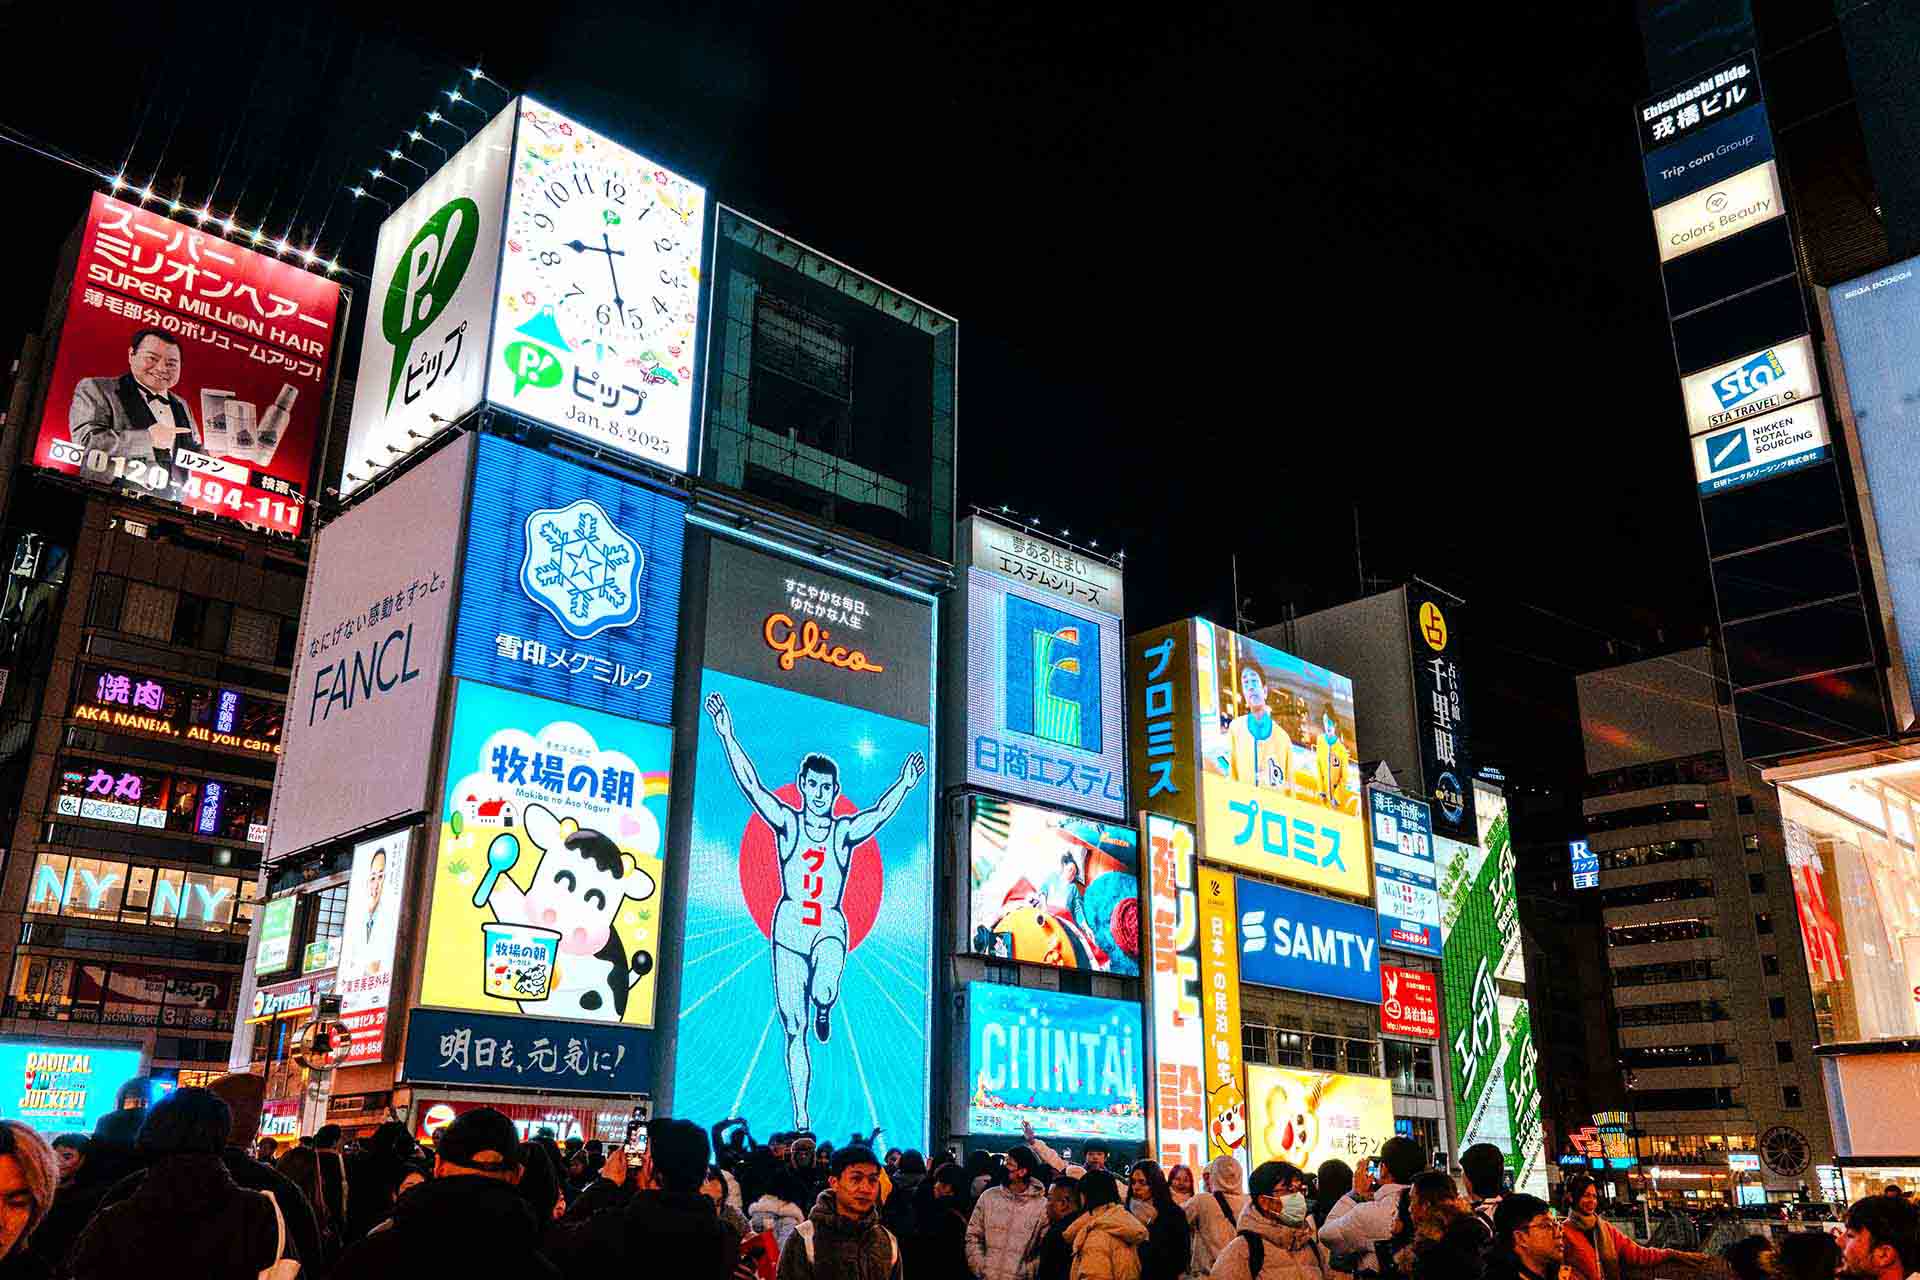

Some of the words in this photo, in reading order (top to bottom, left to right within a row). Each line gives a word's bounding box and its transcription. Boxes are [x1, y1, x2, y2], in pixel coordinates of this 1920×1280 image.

[1643, 78, 1714, 121] Ebisubashi
[1652, 85, 1748, 140] 戎橋ビル
[1661, 152, 1715, 180] Trip.com
[1716, 134, 1754, 156] Group
[544, 181, 571, 209] 10
[571, 173, 596, 197] 11
[604, 178, 626, 205] 12
[98, 203, 235, 264] スーパー
[534, 213, 555, 233] 9
[1670, 220, 1715, 246] Colors
[1719, 198, 1770, 228] Beauty
[94, 233, 329, 329] ミリオンヘアー
[540, 250, 561, 267] 8
[87, 264, 173, 301] SUPER
[179, 296, 263, 335] MILLION
[270, 328, 324, 357] HAIR
[596, 303, 611, 326] 6
[627, 307, 643, 330] 5
[404, 320, 468, 404] ピップ
[572, 364, 648, 416] ピップ
[1711, 411, 1733, 425] STA
[1735, 398, 1777, 418] TRAVEL
[1752, 418, 1794, 436] NIKKEN
[1753, 429, 1789, 444] TOTAL
[1756, 430, 1813, 454] SOURCING
[180, 453, 225, 474] ルアン
[262, 475, 289, 495] 検索
[87, 450, 299, 528] 0120-494-111
[1012, 536, 1088, 575] 夢ある住まい
[309, 572, 446, 658] なにげない感動をずっと。
[791, 597, 864, 630] ゆたかな人生
[1426, 606, 1442, 644] 占
[496, 633, 652, 691] 雪印メグミルク
[764, 612, 884, 672] Glico
[96, 672, 165, 711] 焼肉
[308, 623, 420, 727] FANCL
[75, 704, 110, 723] AKA
[187, 727, 209, 742] All
[212, 730, 240, 748] you
[243, 737, 270, 752] can
[1145, 638, 1180, 797] プロミス
[86, 769, 142, 799] 力丸
[491, 745, 635, 809] 牧場の朝
[975, 735, 1124, 800] 日商エステム
[583, 801, 610, 814] Yogurt
[1229, 799, 1347, 872] プロミス
[36, 864, 120, 909] NY
[154, 879, 231, 921] NY
[801, 846, 826, 927] グリコ
[496, 942, 546, 960] 牧場の朝
[1274, 917, 1375, 971] SAMTY
[1455, 955, 1499, 1100] エイブル
[438, 1028, 625, 1078] 明日を、元気に!
[982, 1022, 1133, 1096] CHINTAI
